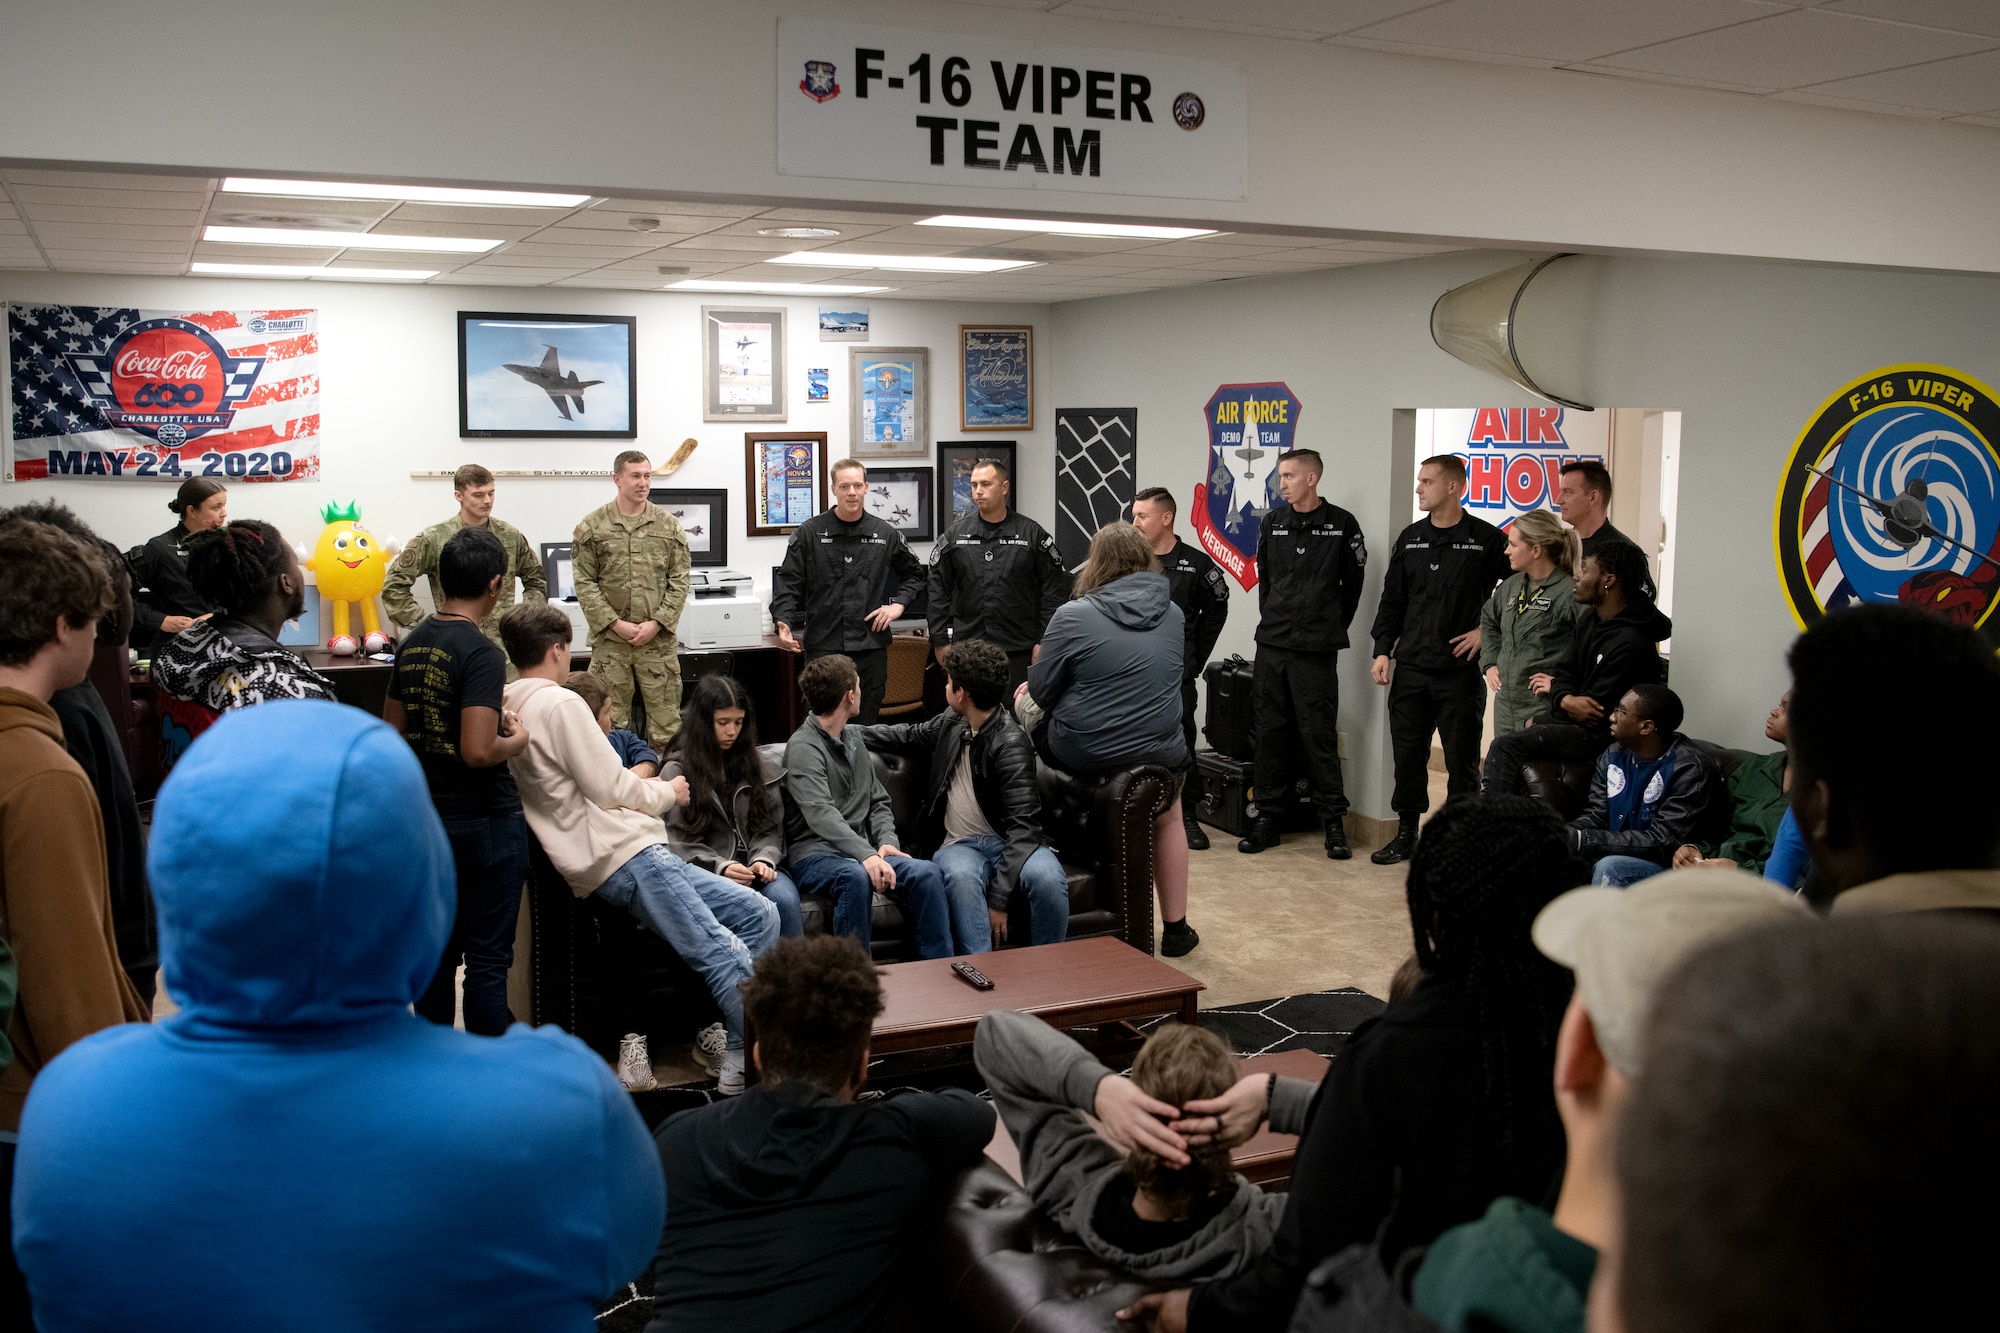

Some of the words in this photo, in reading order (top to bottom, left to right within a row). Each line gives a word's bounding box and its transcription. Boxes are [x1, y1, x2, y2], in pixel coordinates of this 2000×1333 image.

[855, 48, 972, 107] F-16
[990, 60, 1153, 123] VIPER
[916, 115, 1101, 177] TEAM
[268, 320, 304, 328] CHARLOTTE
[116, 349, 213, 380] Coca-Cola
[978, 355, 1016, 387] 70
[133, 383, 205, 408] 600
[1849, 380, 1895, 413] F-16
[1907, 378, 1975, 413] VIPER
[121, 414, 193, 424] CHARLOTTE,
[197, 414, 221, 424] USA
[1216, 401, 1241, 425] AIR
[1243, 399, 1289, 424] FORCE
[1221, 431, 1241, 444] DEMO
[1260, 431, 1281, 444] TEAM
[1467, 408, 1570, 450] AIR
[48, 450, 131, 476] MAY
[136, 452, 193, 480] 24,
[201, 451, 294, 477] 2020
[1451, 453, 1604, 512] HO
[1202, 526, 1245, 579] HERITAGE
